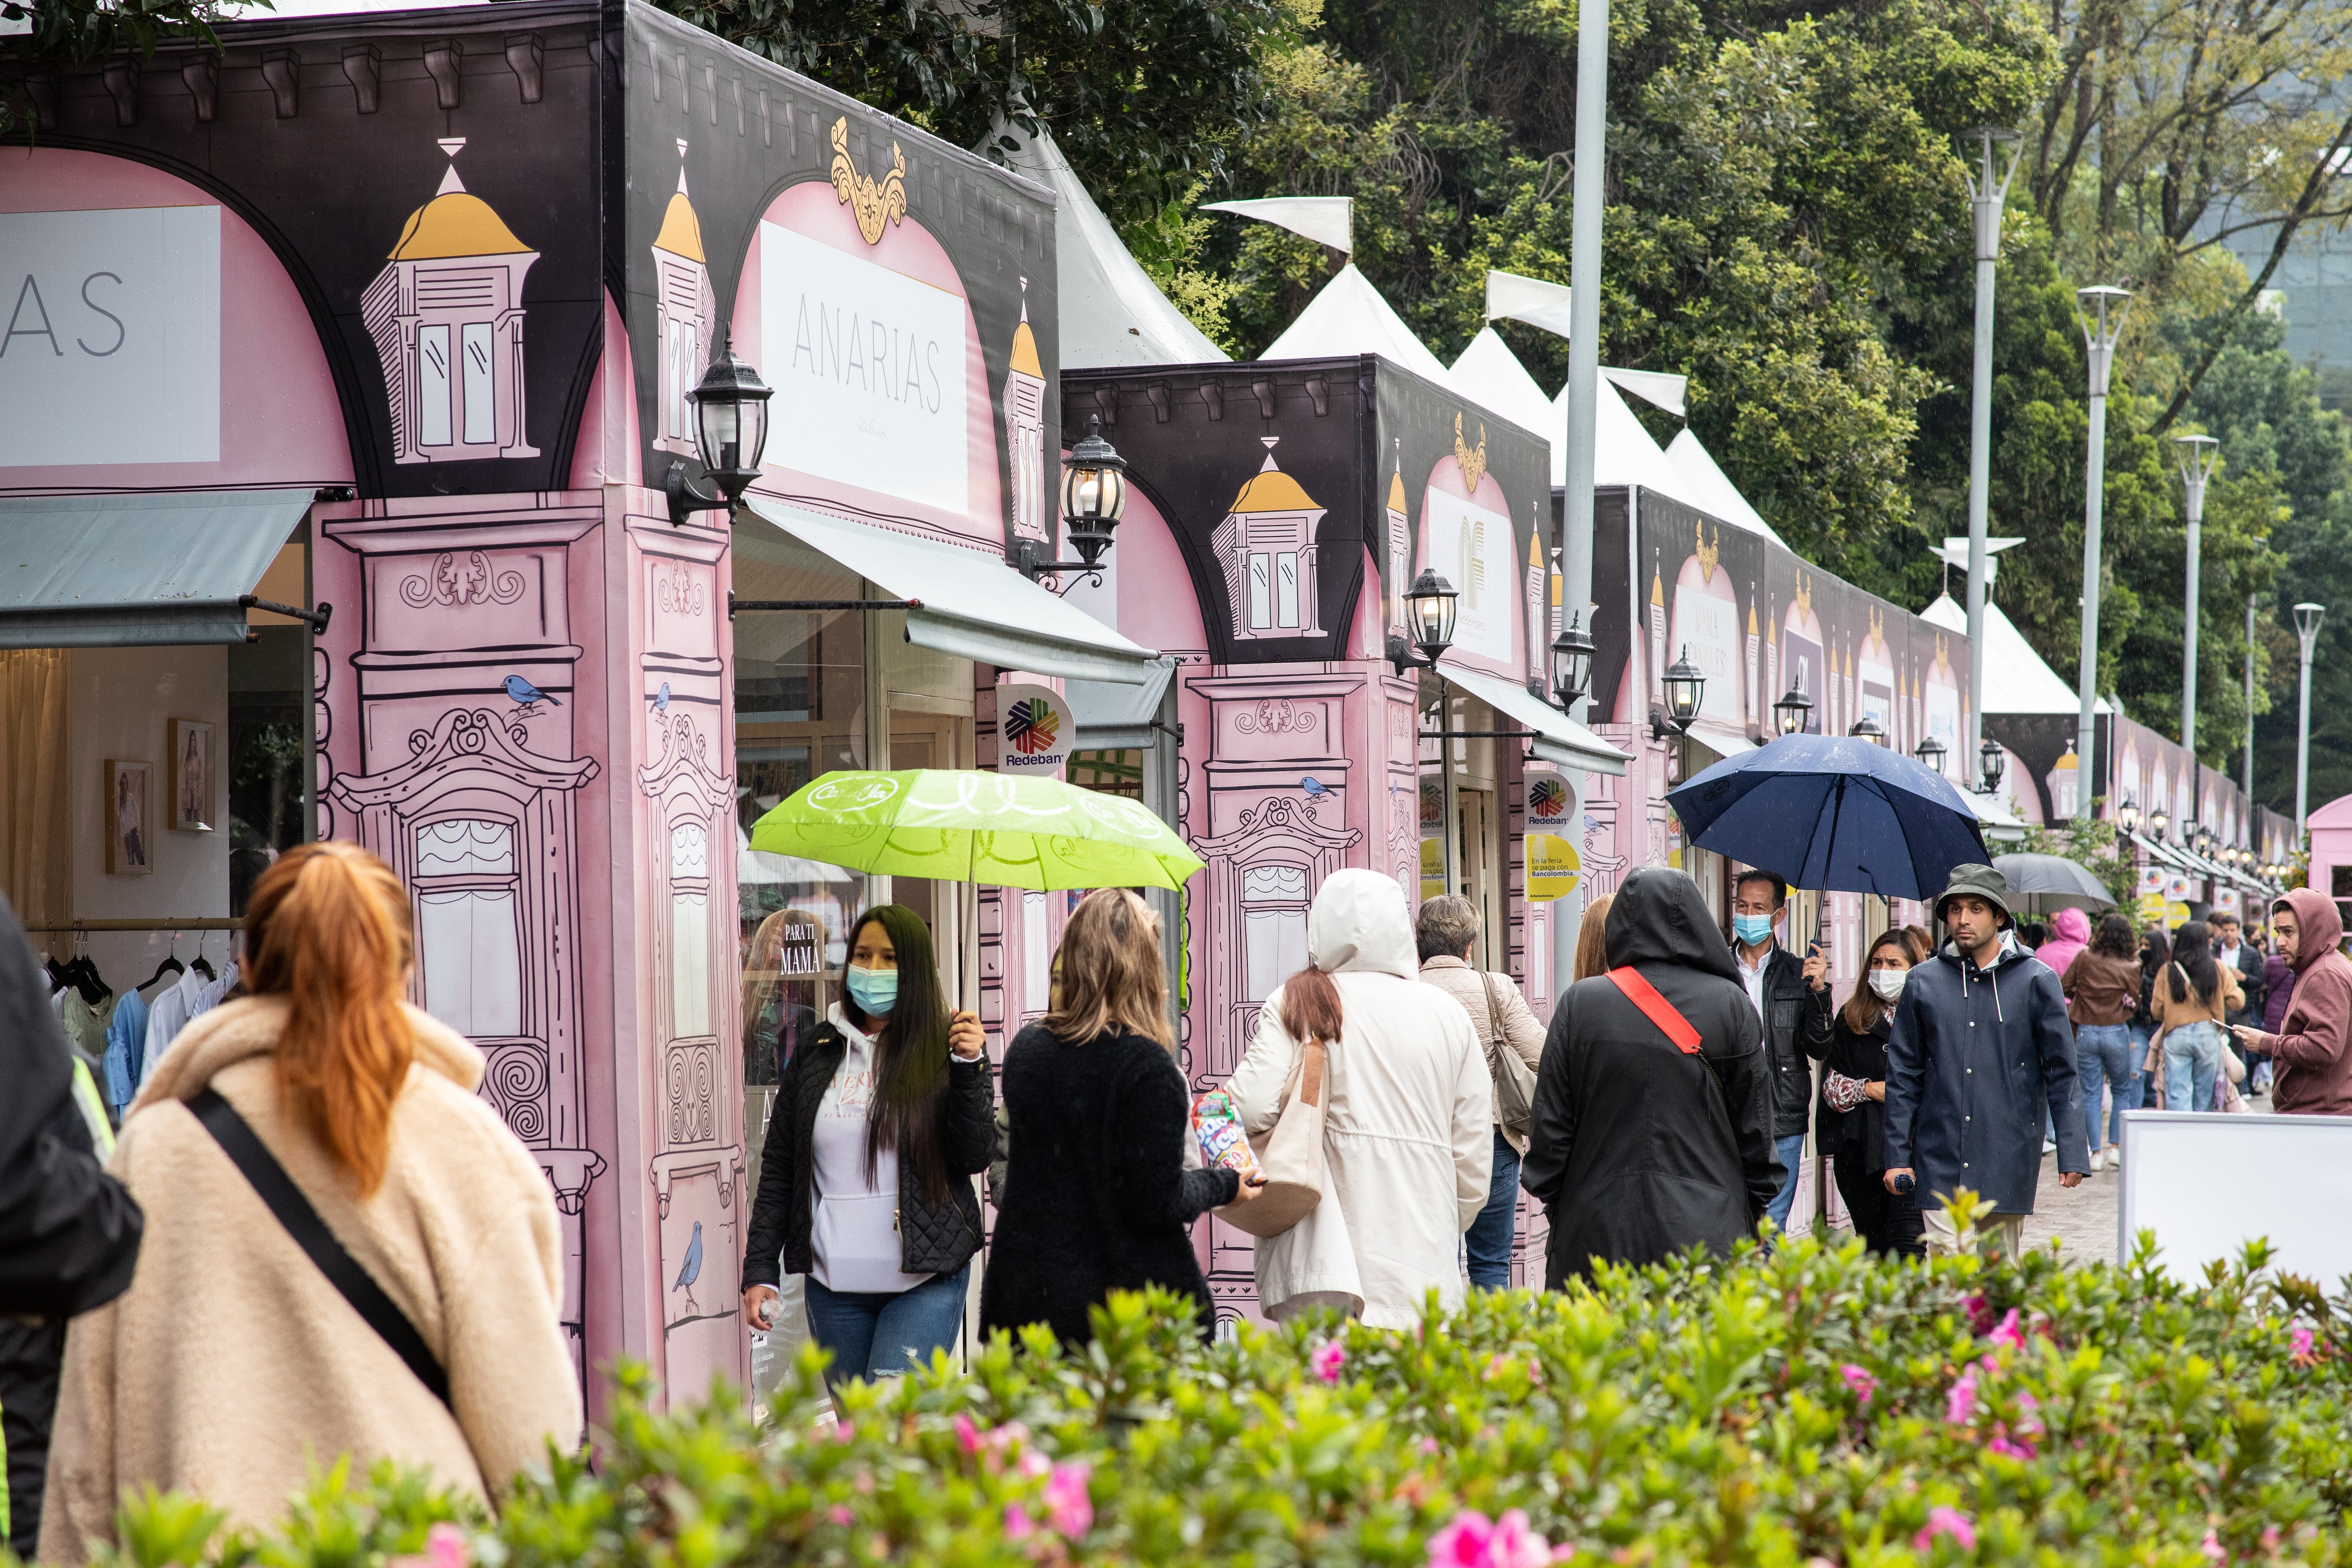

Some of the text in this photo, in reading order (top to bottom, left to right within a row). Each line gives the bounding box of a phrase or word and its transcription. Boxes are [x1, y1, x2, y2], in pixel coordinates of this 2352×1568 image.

[792, 293, 940, 414] ANARIAS
[1006, 754, 1062, 766] Redeban
[785, 924, 814, 940] PARA TI
[780, 939, 820, 975] MAMÁ
